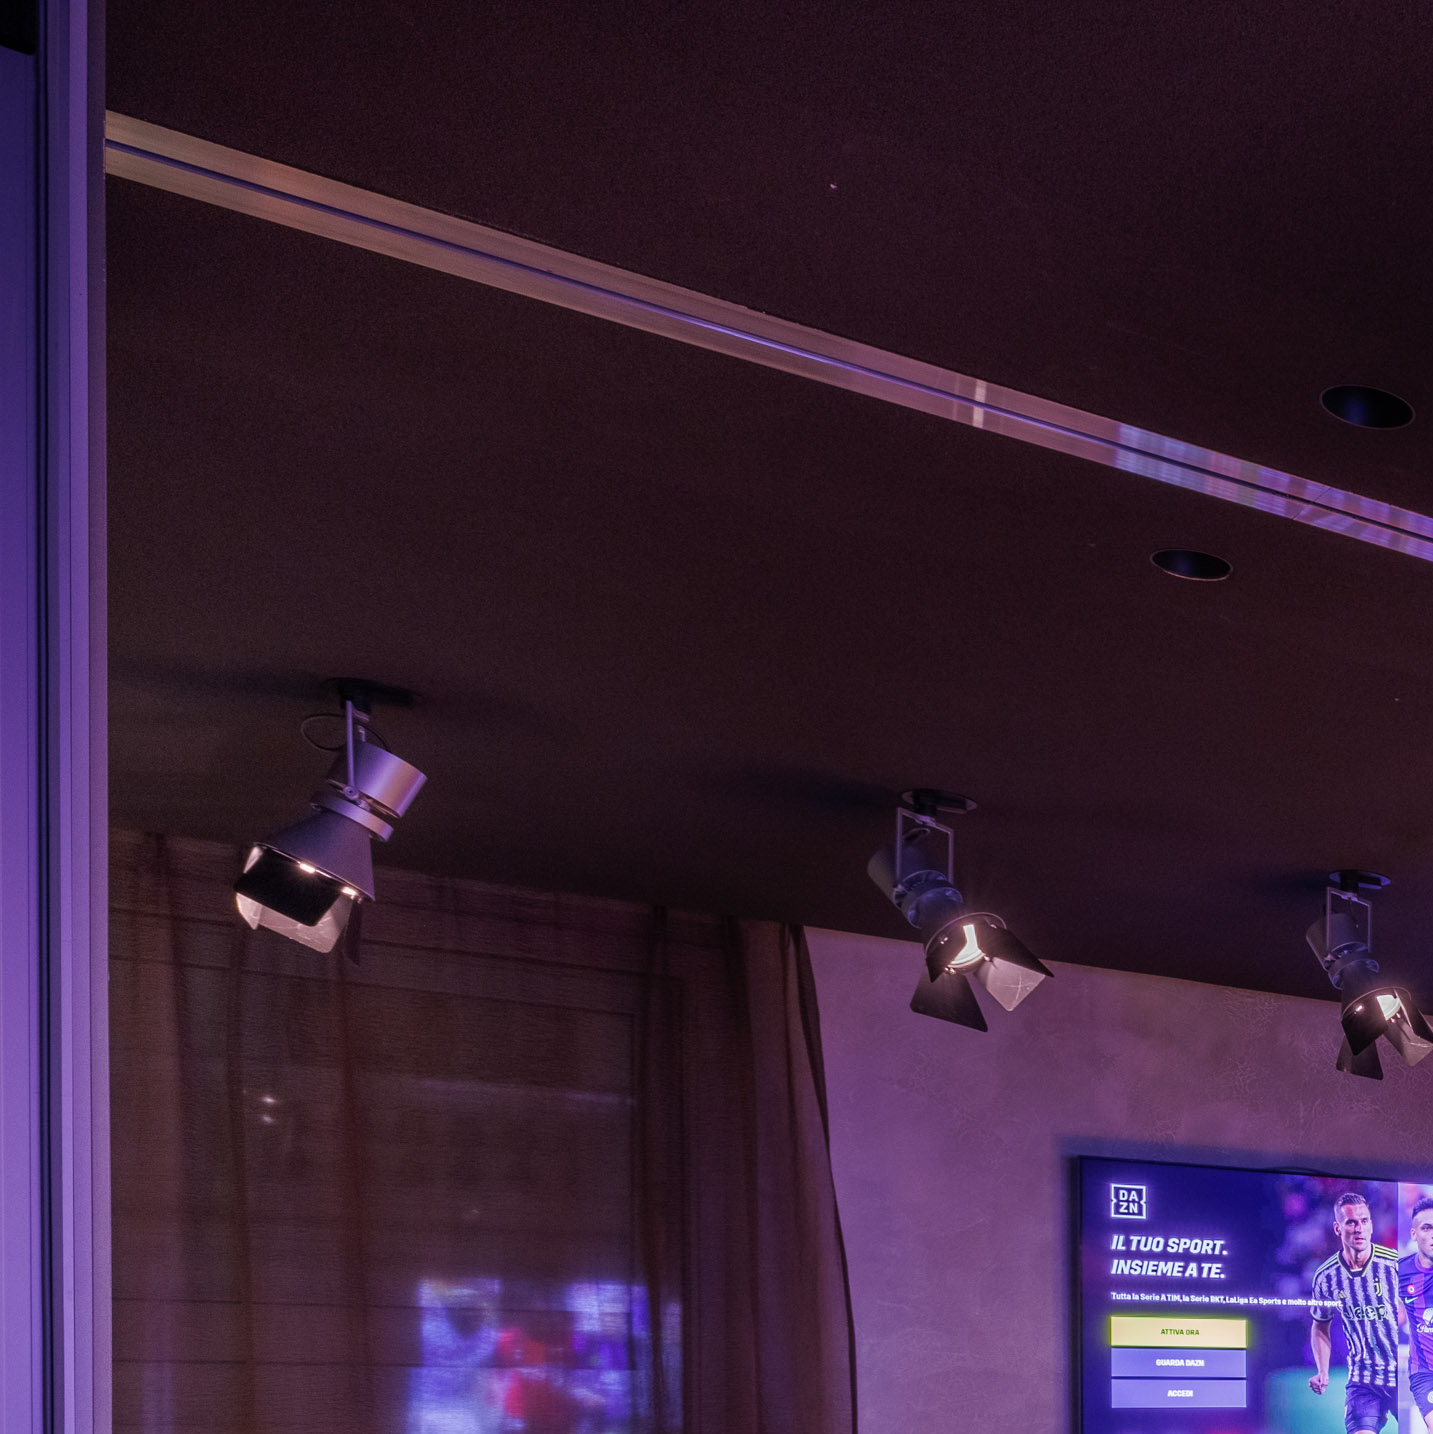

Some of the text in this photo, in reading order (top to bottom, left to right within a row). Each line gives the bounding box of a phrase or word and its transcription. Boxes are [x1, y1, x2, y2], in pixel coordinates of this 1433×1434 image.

[1111, 1235, 1228, 1255] IL TUO SPORT.
[1111, 1259, 1225, 1279] INSIEME A TE.
[1111, 1292, 1131, 1300] Tutta
[1132, 1293, 1140, 1301] la
[1140, 1293, 1160, 1301] Serie
[1167, 1294, 1183, 1303] TIM,
[1183, 1294, 1190, 1302] la
[1190, 1295, 1210, 1303] Serie
[1226, 1296, 1249, 1305] LaLiga
[1258, 1297, 1281, 1306] Sports
[1287, 1298, 1307, 1306] molto
[1324, 1300, 1344, 1308] sport.
[1155, 1359, 1205, 1367] GUARDA DAZN
[1167, 1389, 1194, 1398] ACCEDI
